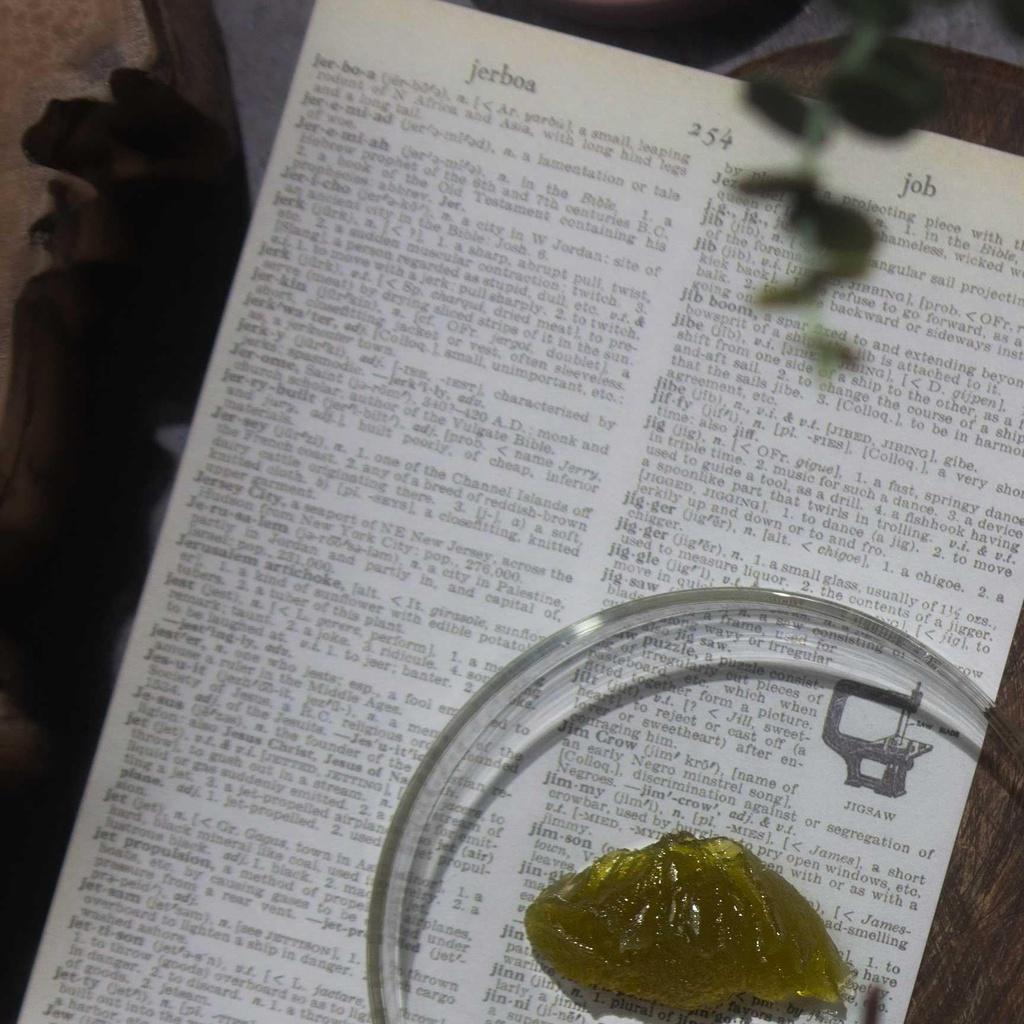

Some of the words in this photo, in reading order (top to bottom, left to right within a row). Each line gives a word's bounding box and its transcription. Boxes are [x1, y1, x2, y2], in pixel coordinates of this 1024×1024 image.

[465, 59, 536, 93] jerboa
[688, 123, 732, 150] 254
[898, 172, 936, 197] job
[924, 217, 961, 233] piece
[971, 229, 1002, 245] with
[925, 227, 938, 242] in
[947, 235, 970, 249] the
[930, 275, 955, 288] sail
[830, 301, 899, 328] backward
[905, 322, 921, 333] or
[926, 328, 991, 351] sideways
[832, 291, 875, 308] refuse
[882, 301, 897, 313] to
[902, 309, 920, 319] go
[993, 332, 1008, 343] as
[853, 334, 867, 345] to
[872, 341, 900, 355] and
[904, 350, 976, 377] extending
[673, 345, 726, 364] and-aft
[798, 375, 812, 386] to
[820, 382, 869, 402] change
[877, 395, 900, 410] the
[907, 405, 952, 424] course
[959, 419, 976, 430] of
[688, 497, 706, 511] up
[711, 504, 738, 518] and
[744, 510, 782, 530] down
[788, 524, 804, 535] or
[809, 527, 824, 540] to
[829, 535, 856, 549] and
[621, 532, 652, 550] used
[659, 543, 672, 555] to
[678, 550, 738, 572] measure
[820, 586, 843, 601] the
[849, 595, 910, 618] contents
[915, 613, 931, 624] of
[699, 689, 732, 708] form
[618, 712, 634, 722] or
[642, 718, 726, 749] sweetheart)
[735, 743, 772, 760] after
[780, 755, 803, 767] en-
[633, 701, 648, 713] to
[655, 708, 697, 726] reject
[704, 721, 721, 732] or
[727, 728, 757, 742] cast
[764, 737, 786, 750] off
[793, 743, 806, 756] (a
[843, 801, 896, 821] JIGSAW
[757, 845, 783, 860] pry
[786, 854, 820, 870] open
